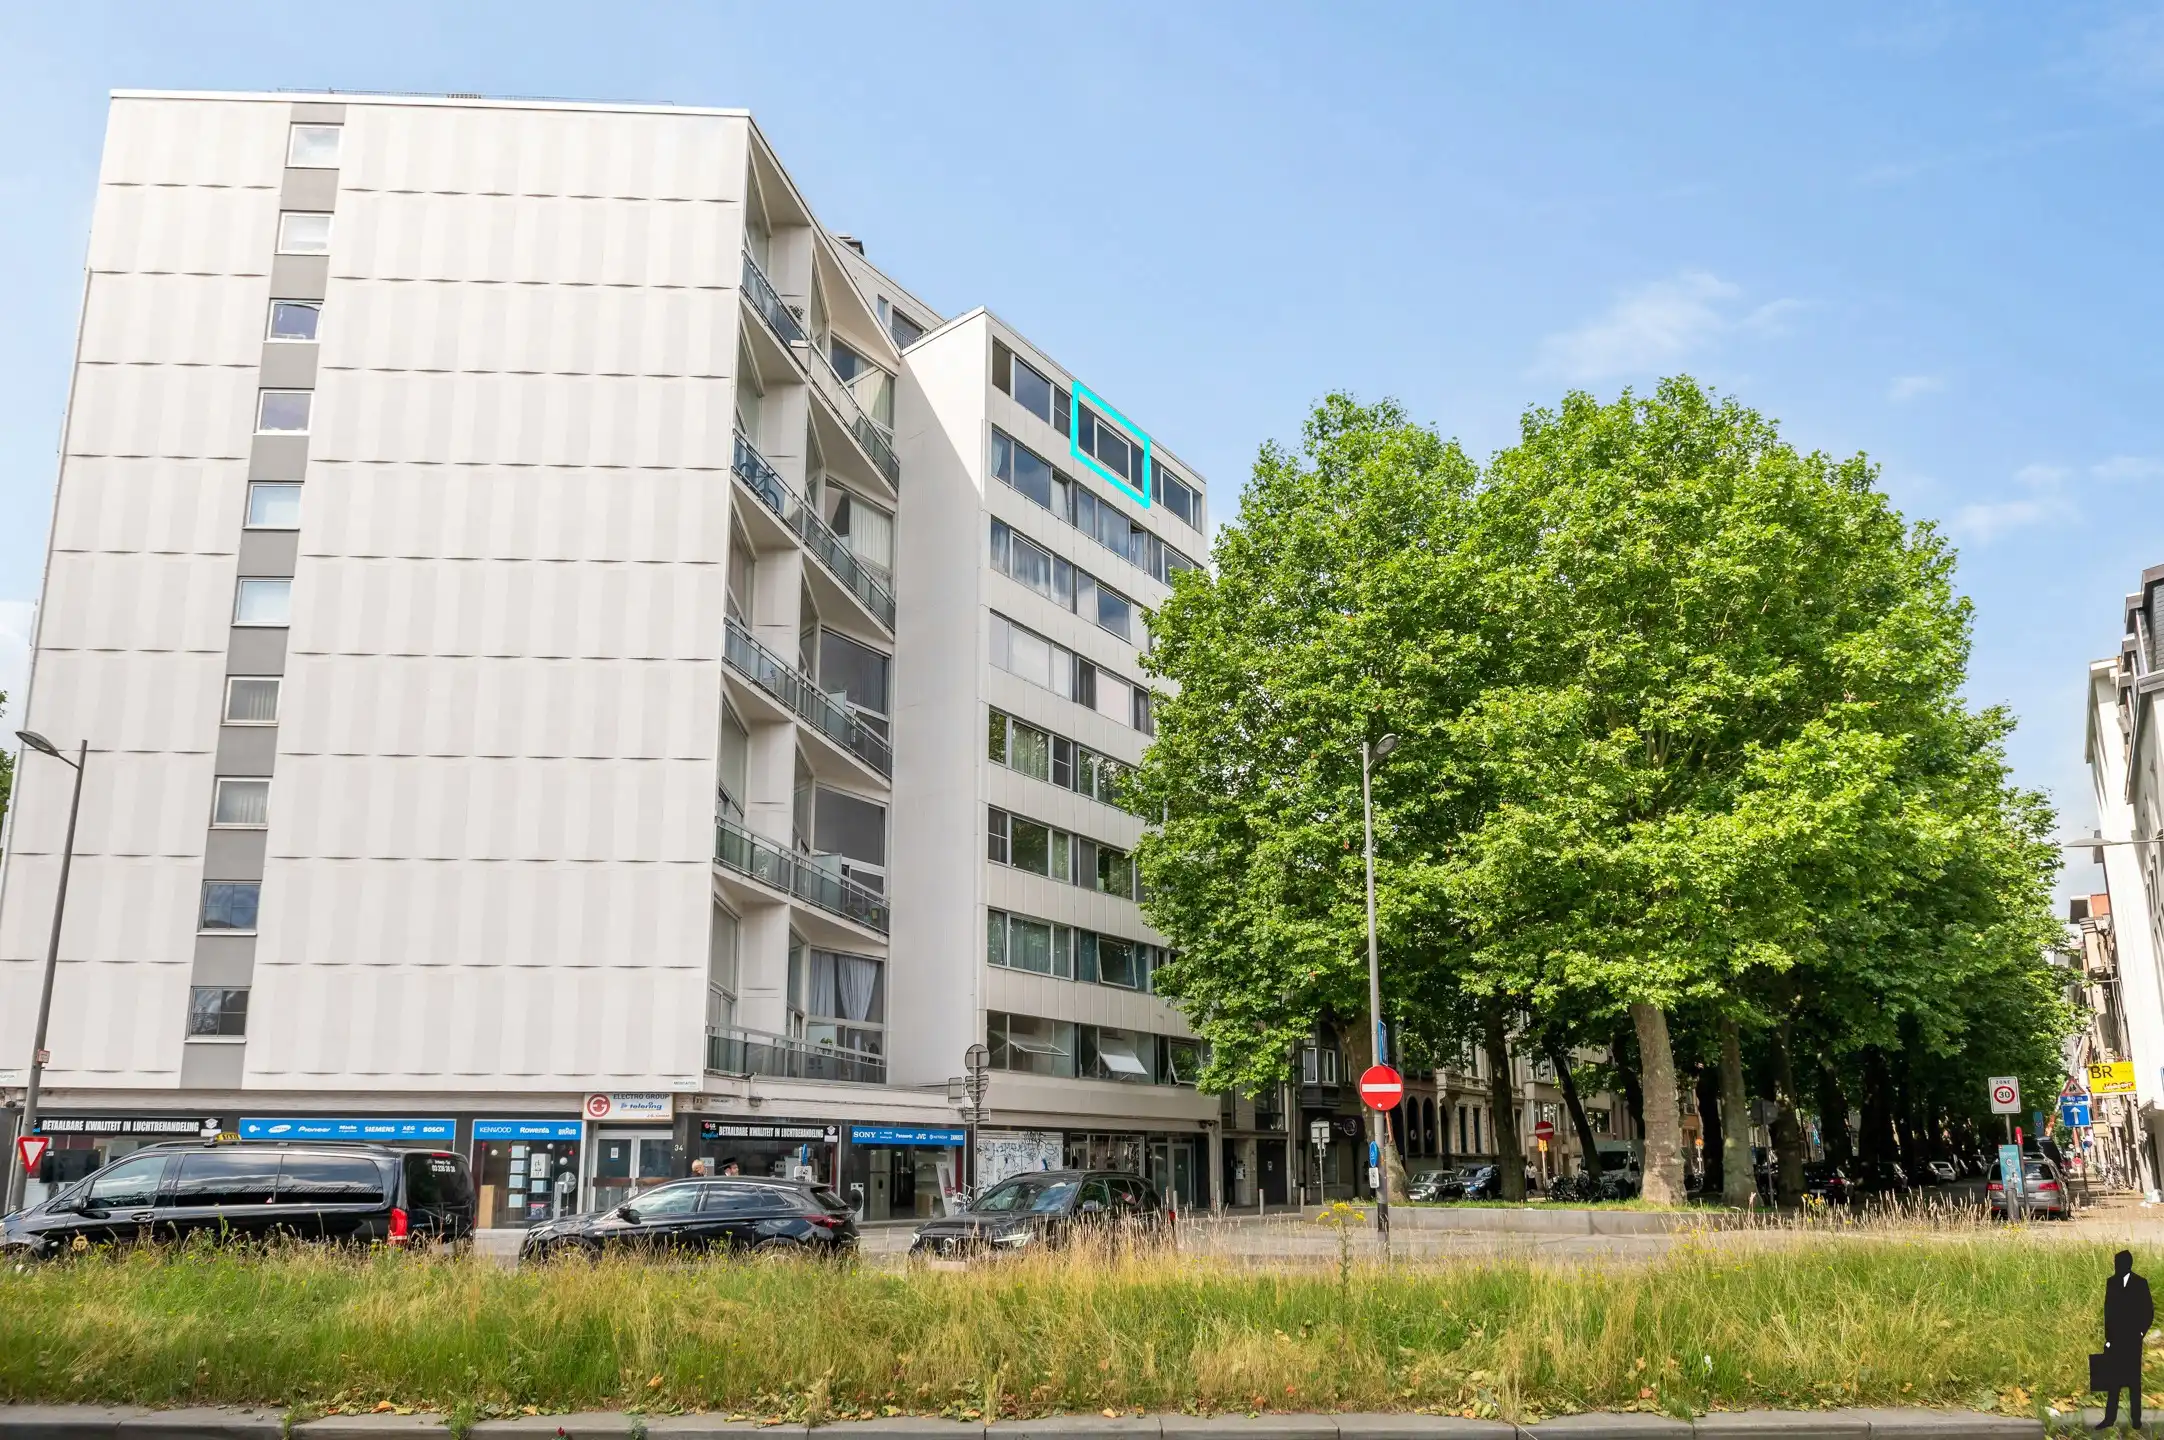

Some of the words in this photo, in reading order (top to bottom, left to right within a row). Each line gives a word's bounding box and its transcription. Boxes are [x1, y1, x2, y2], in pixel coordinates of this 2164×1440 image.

[2091, 1065, 2113, 1079] BR
[1998, 1091, 2011, 1099] 30
[42, 1119, 84, 1131] BETAALBARE
[85, 1120, 122, 1132] KWALITEIT
[122, 1120, 132, 1132] IN
[132, 1121, 200, 1133] LUCHTBEHANDELING
[718, 1126, 748, 1136] BETAALBARE
[748, 1127, 774, 1137] KWALITEIT
[774, 1127, 781, 1137] IN
[781, 1128, 824, 1138] LUCHTBEHANDELING
